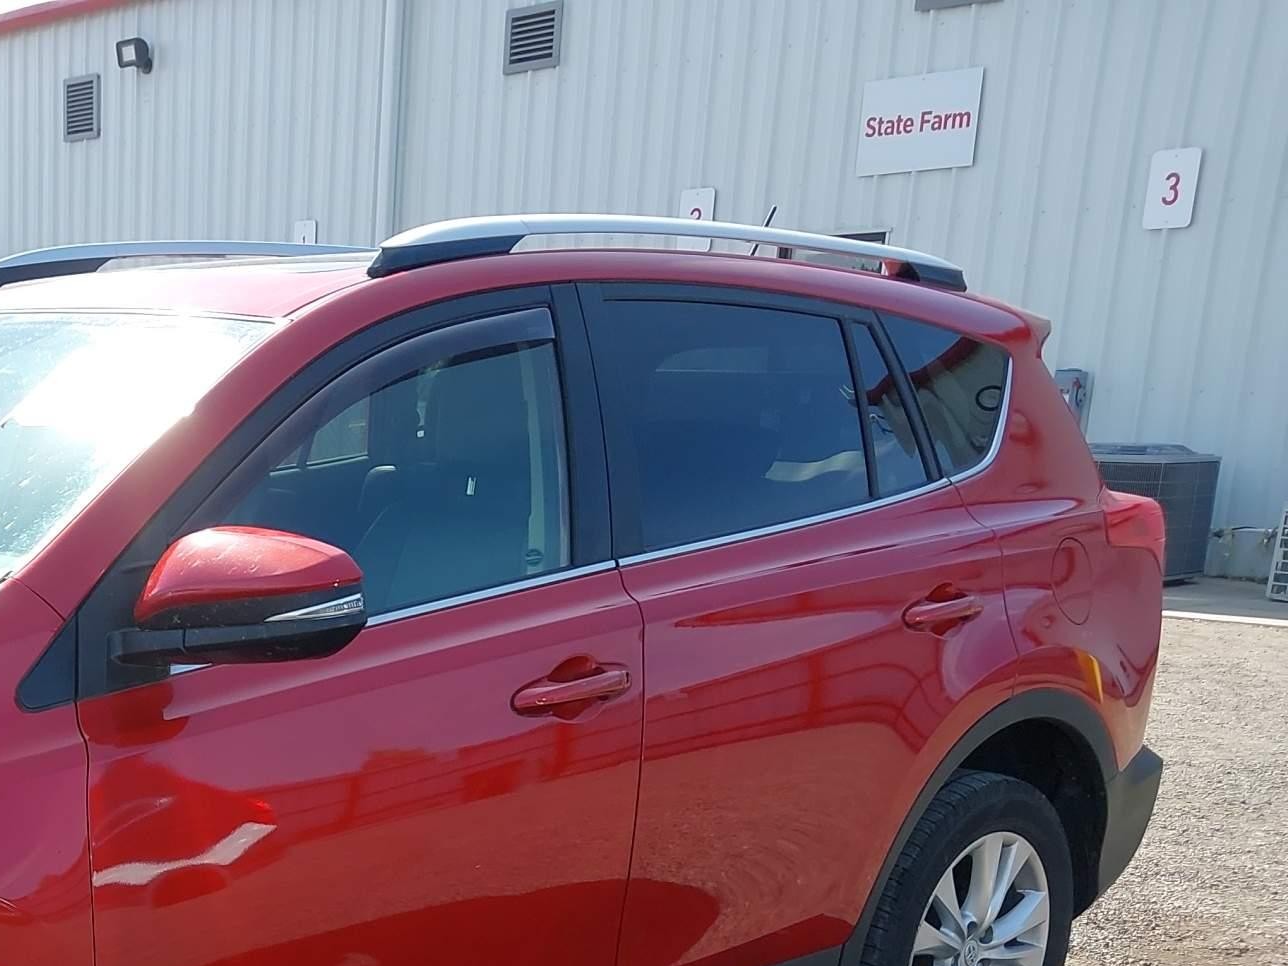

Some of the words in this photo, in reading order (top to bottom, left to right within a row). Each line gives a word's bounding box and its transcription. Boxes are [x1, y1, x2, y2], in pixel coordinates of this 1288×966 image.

[864, 114, 914, 138] State
[919, 110, 971, 132] Farm
[1161, 172, 1181, 206] 3
